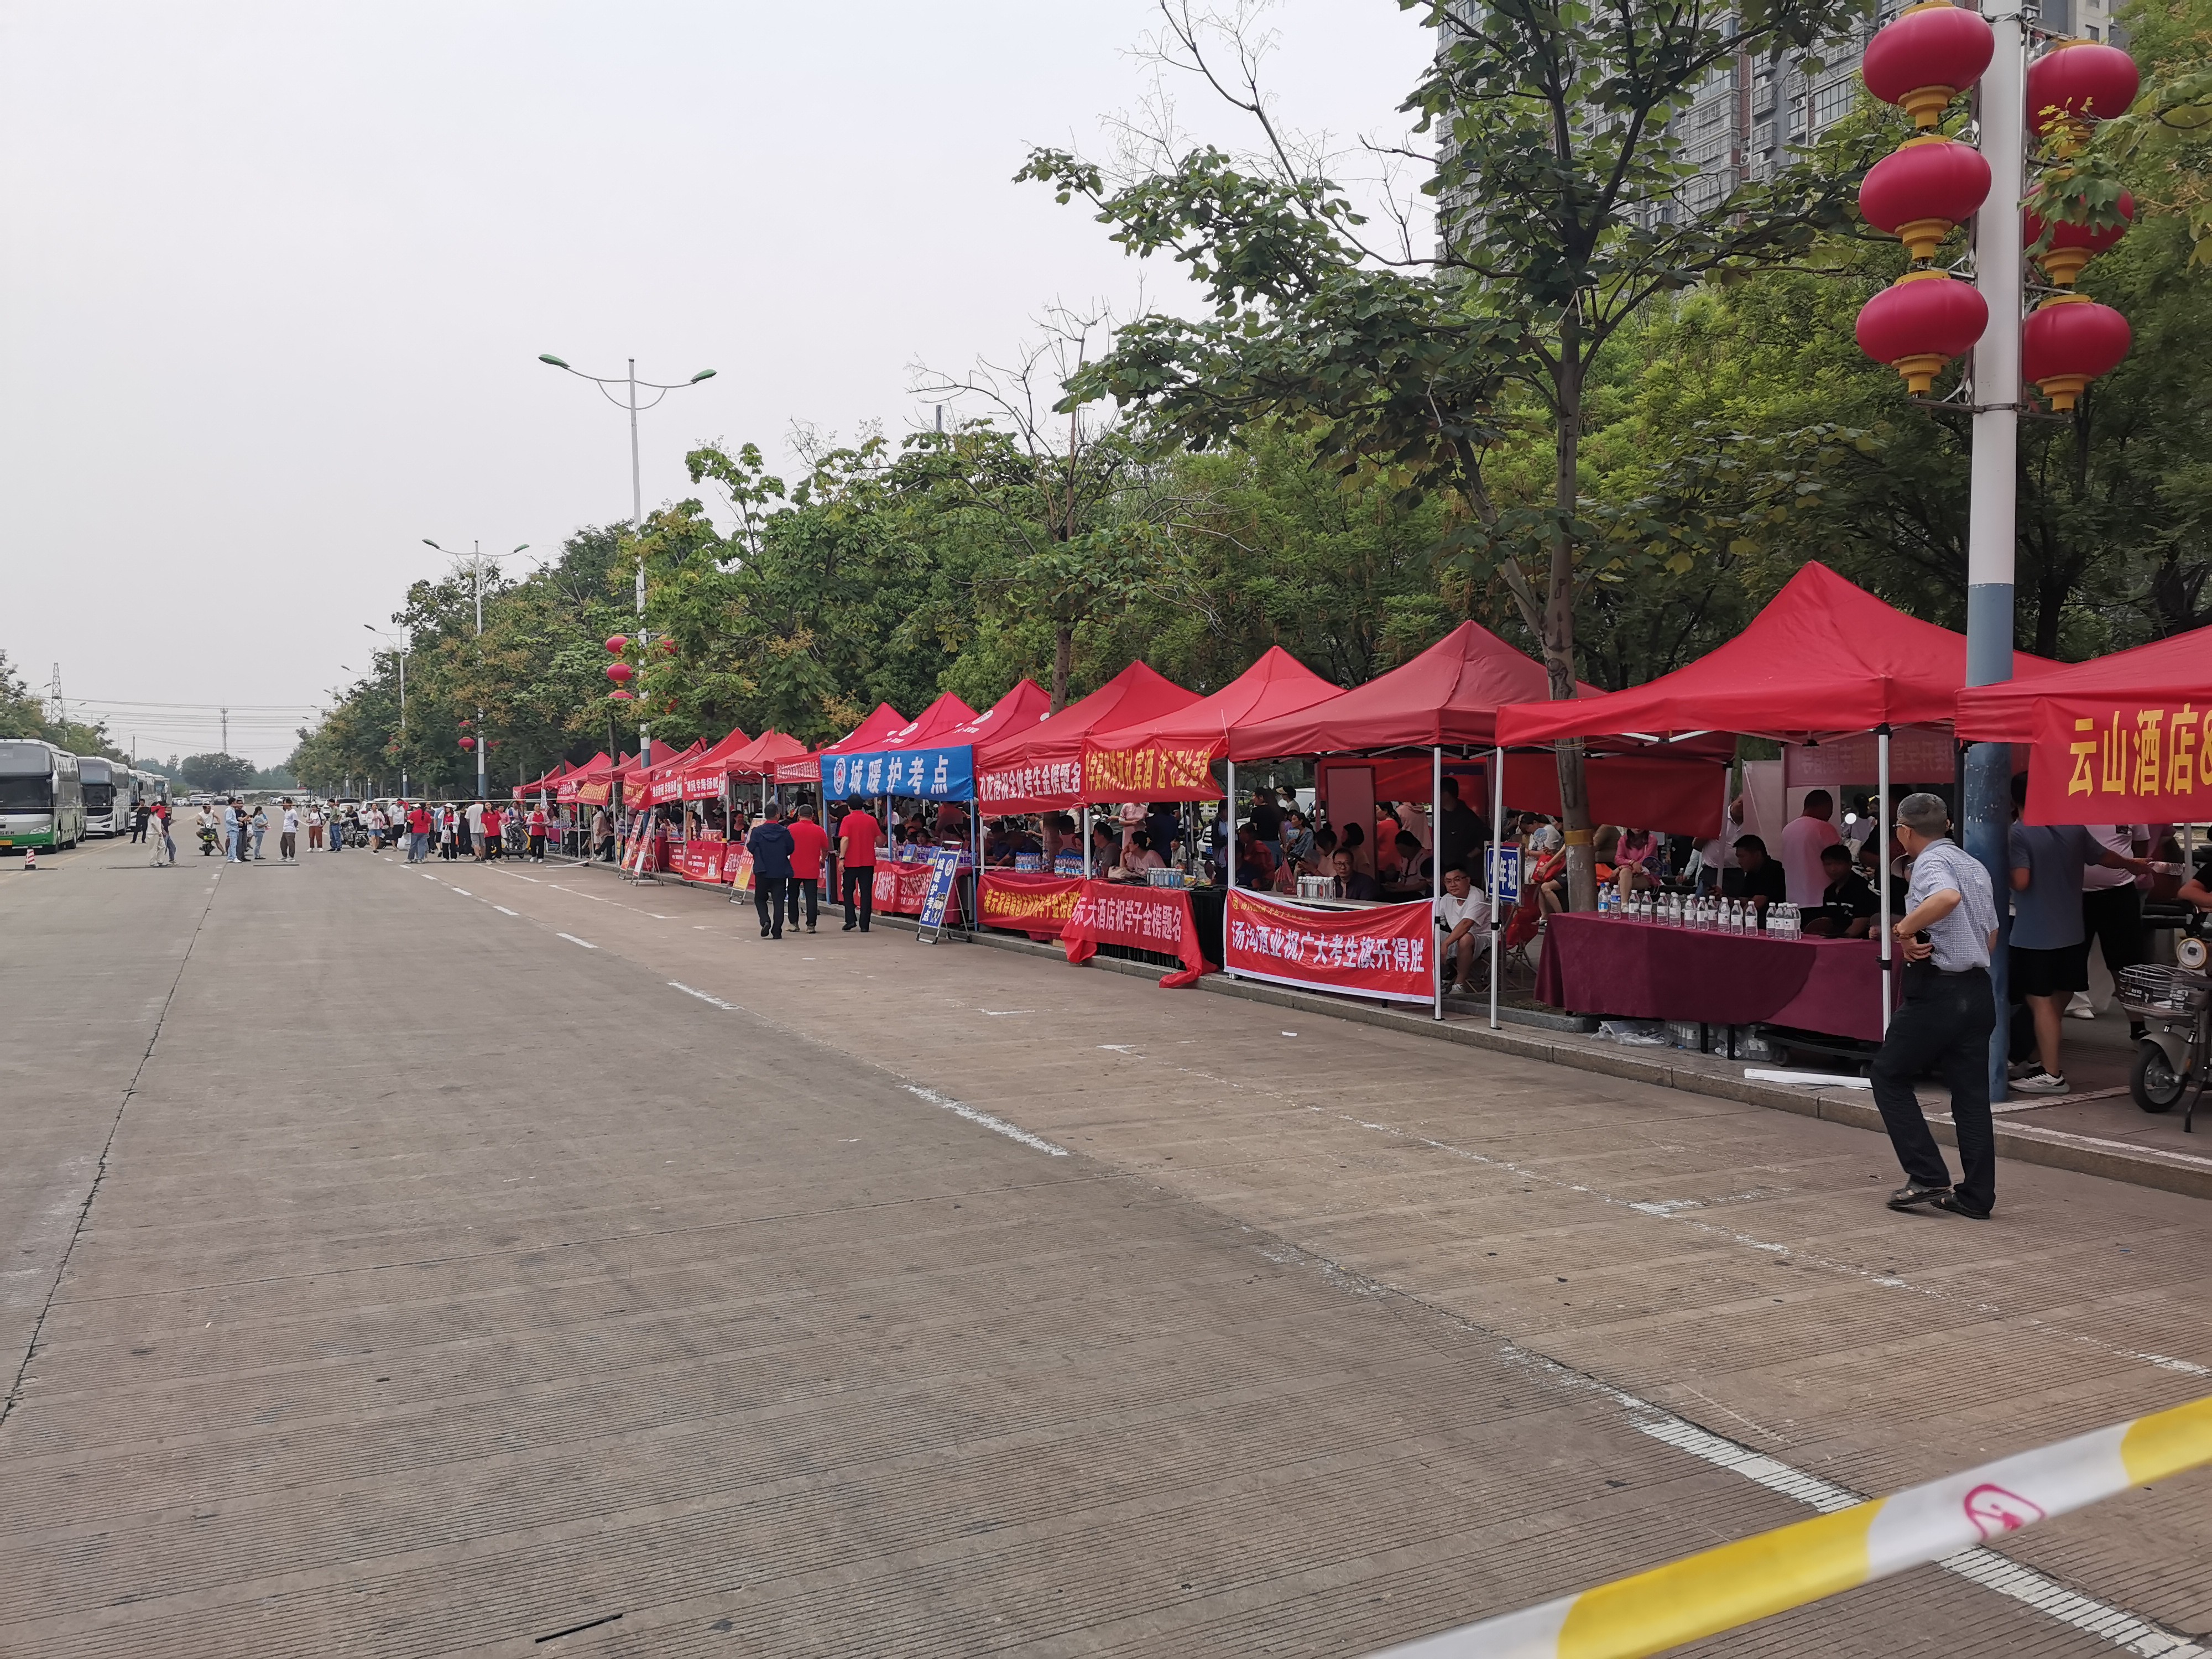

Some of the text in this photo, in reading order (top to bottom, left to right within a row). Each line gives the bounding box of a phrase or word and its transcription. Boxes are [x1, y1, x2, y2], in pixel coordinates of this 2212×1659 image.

[848, 754, 949, 795] 城暖护考点
[979, 761, 1081, 802] 九龙港祝全体考生金榜题名
[1231, 920, 1425, 973] 汤沟酒业祝广大考生旗开得胜
